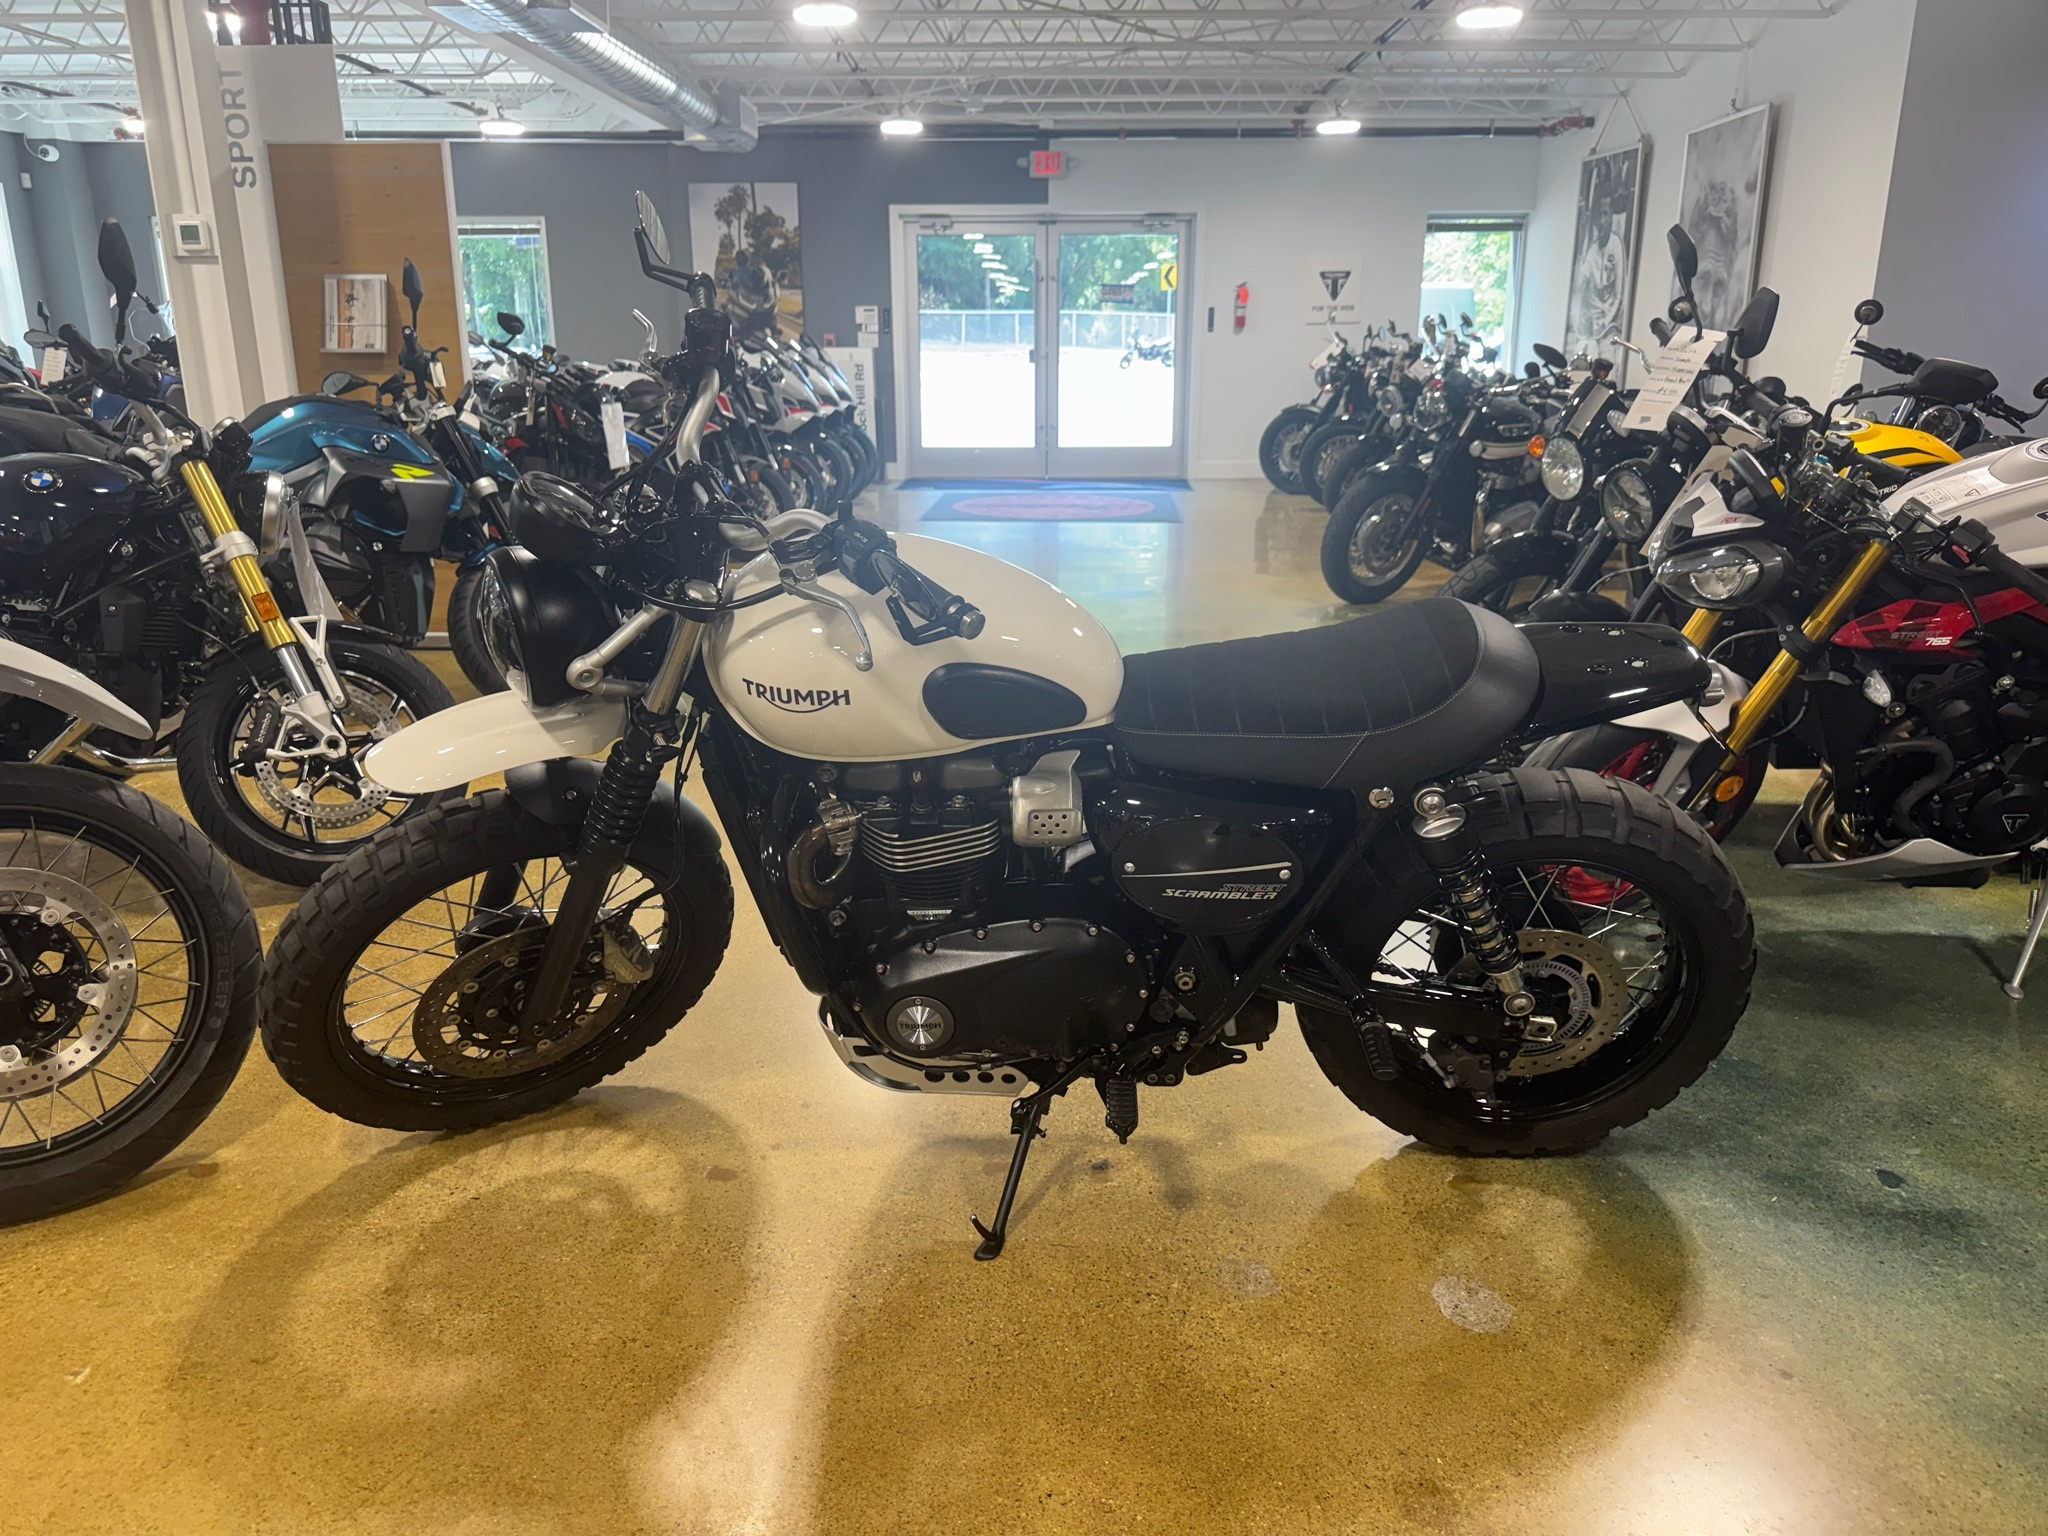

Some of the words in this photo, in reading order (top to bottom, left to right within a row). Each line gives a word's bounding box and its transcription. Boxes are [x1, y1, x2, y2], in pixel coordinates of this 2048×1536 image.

[217, 62, 257, 189] SPORT
[1036, 151, 1062, 175] EXIT
[855, 363, 865, 381] Rd
[855, 384, 866, 406] Hill
[857, 409, 867, 432] ock
[1878, 484, 1899, 496] TRID
[1890, 630, 1943, 640] STREET
[1925, 637, 1953, 646] 765
[742, 677, 851, 711] TRIUMPH
[255, 712, 272, 744] brembo
[1161, 888, 1278, 900] SCRAMBLER
[1219, 883, 1288, 892] STREET
[899, 1022, 942, 1032] TRIUMPH
